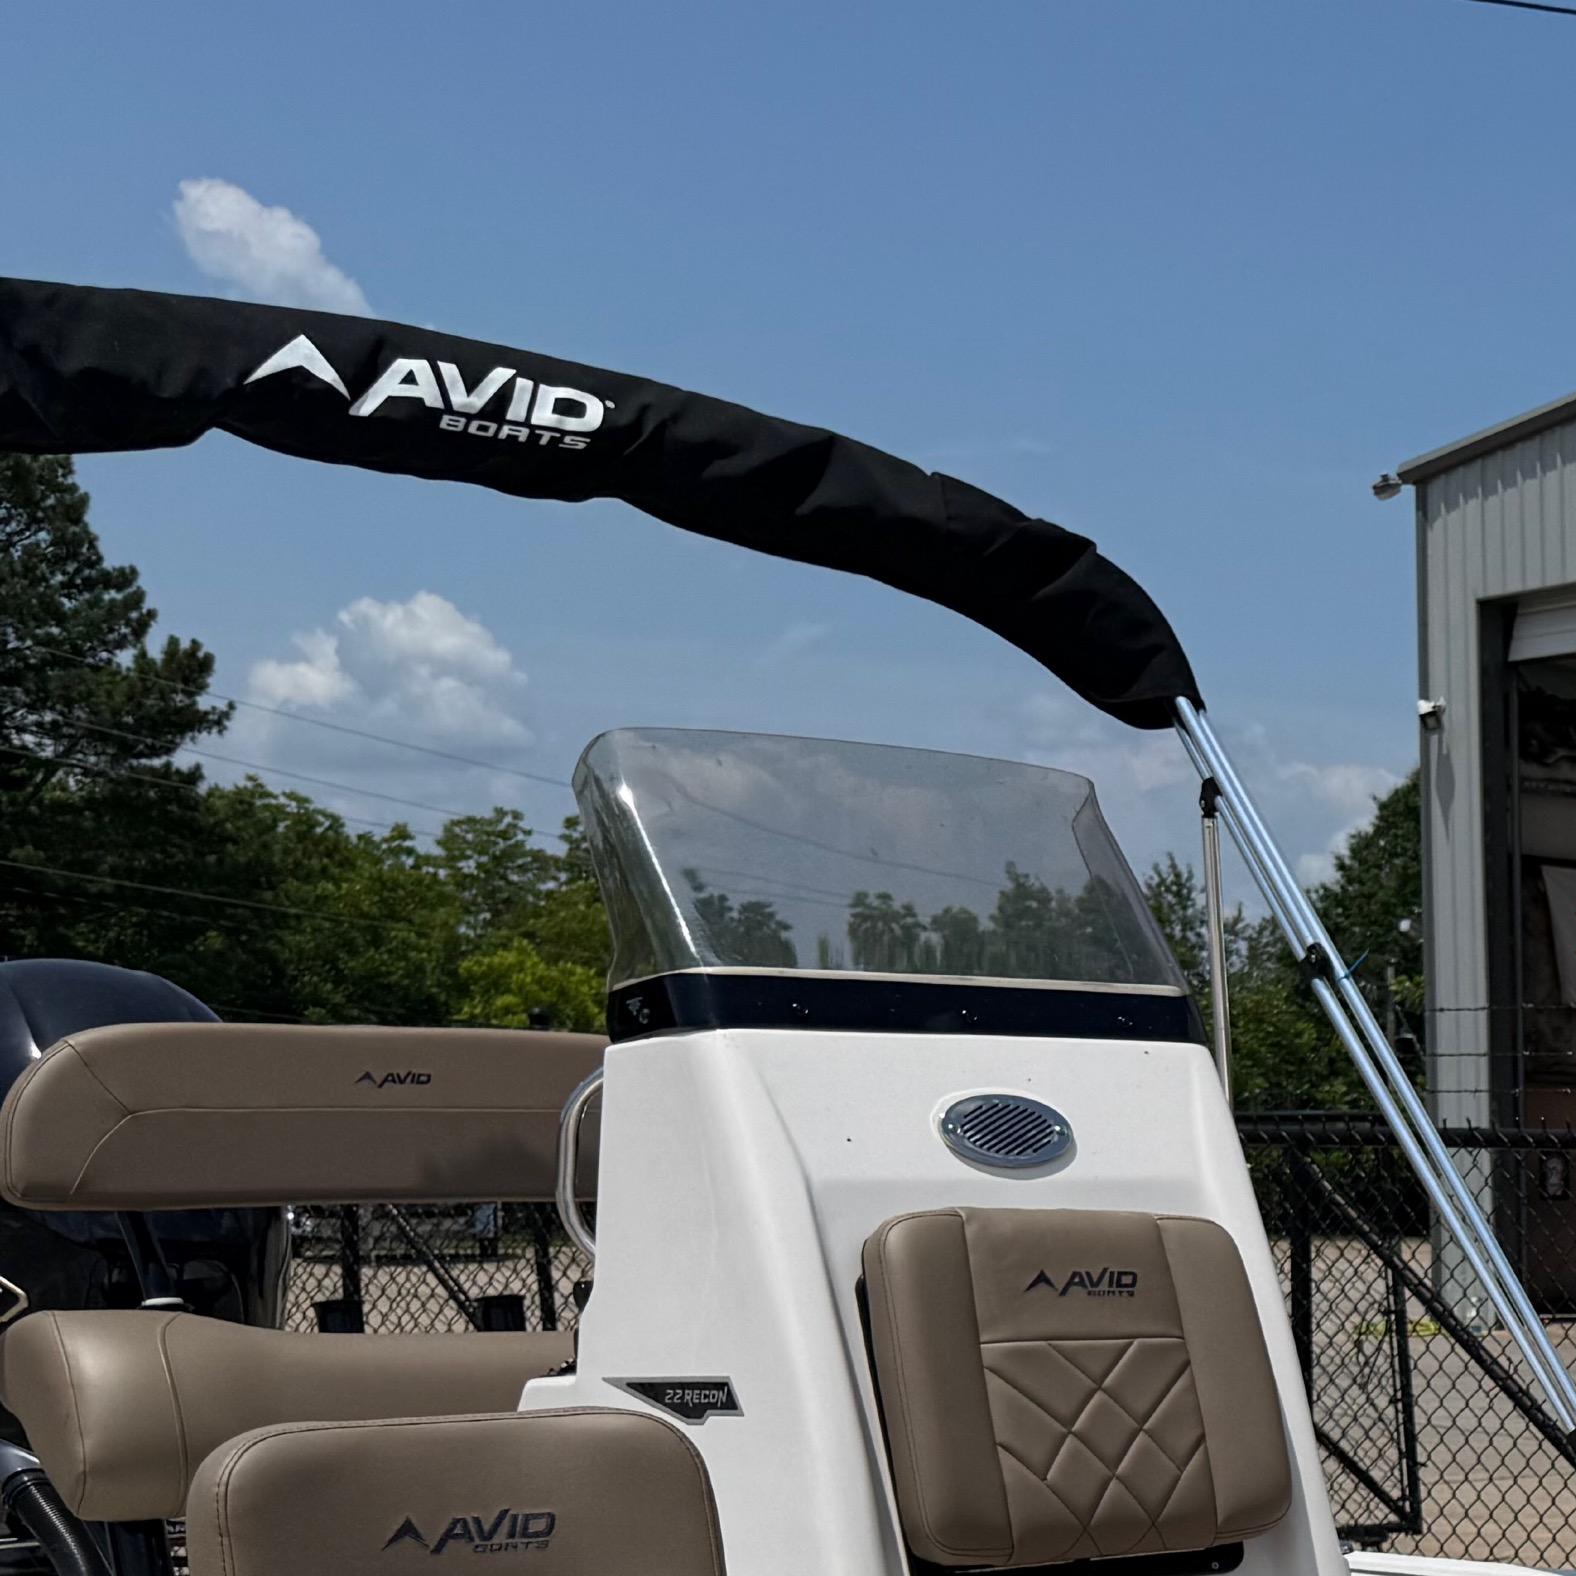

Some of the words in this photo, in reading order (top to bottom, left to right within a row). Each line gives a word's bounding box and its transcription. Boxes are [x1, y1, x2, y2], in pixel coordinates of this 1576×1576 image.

[348, 357, 605, 433] AVID
[439, 413, 593, 450] BOATS
[378, 1070, 432, 1089] AVID
[1058, 1266, 1138, 1297] AVID
[664, 1389, 682, 1403] 22
[684, 1386, 728, 1408] RECON
[429, 1507, 557, 1555] AVID
